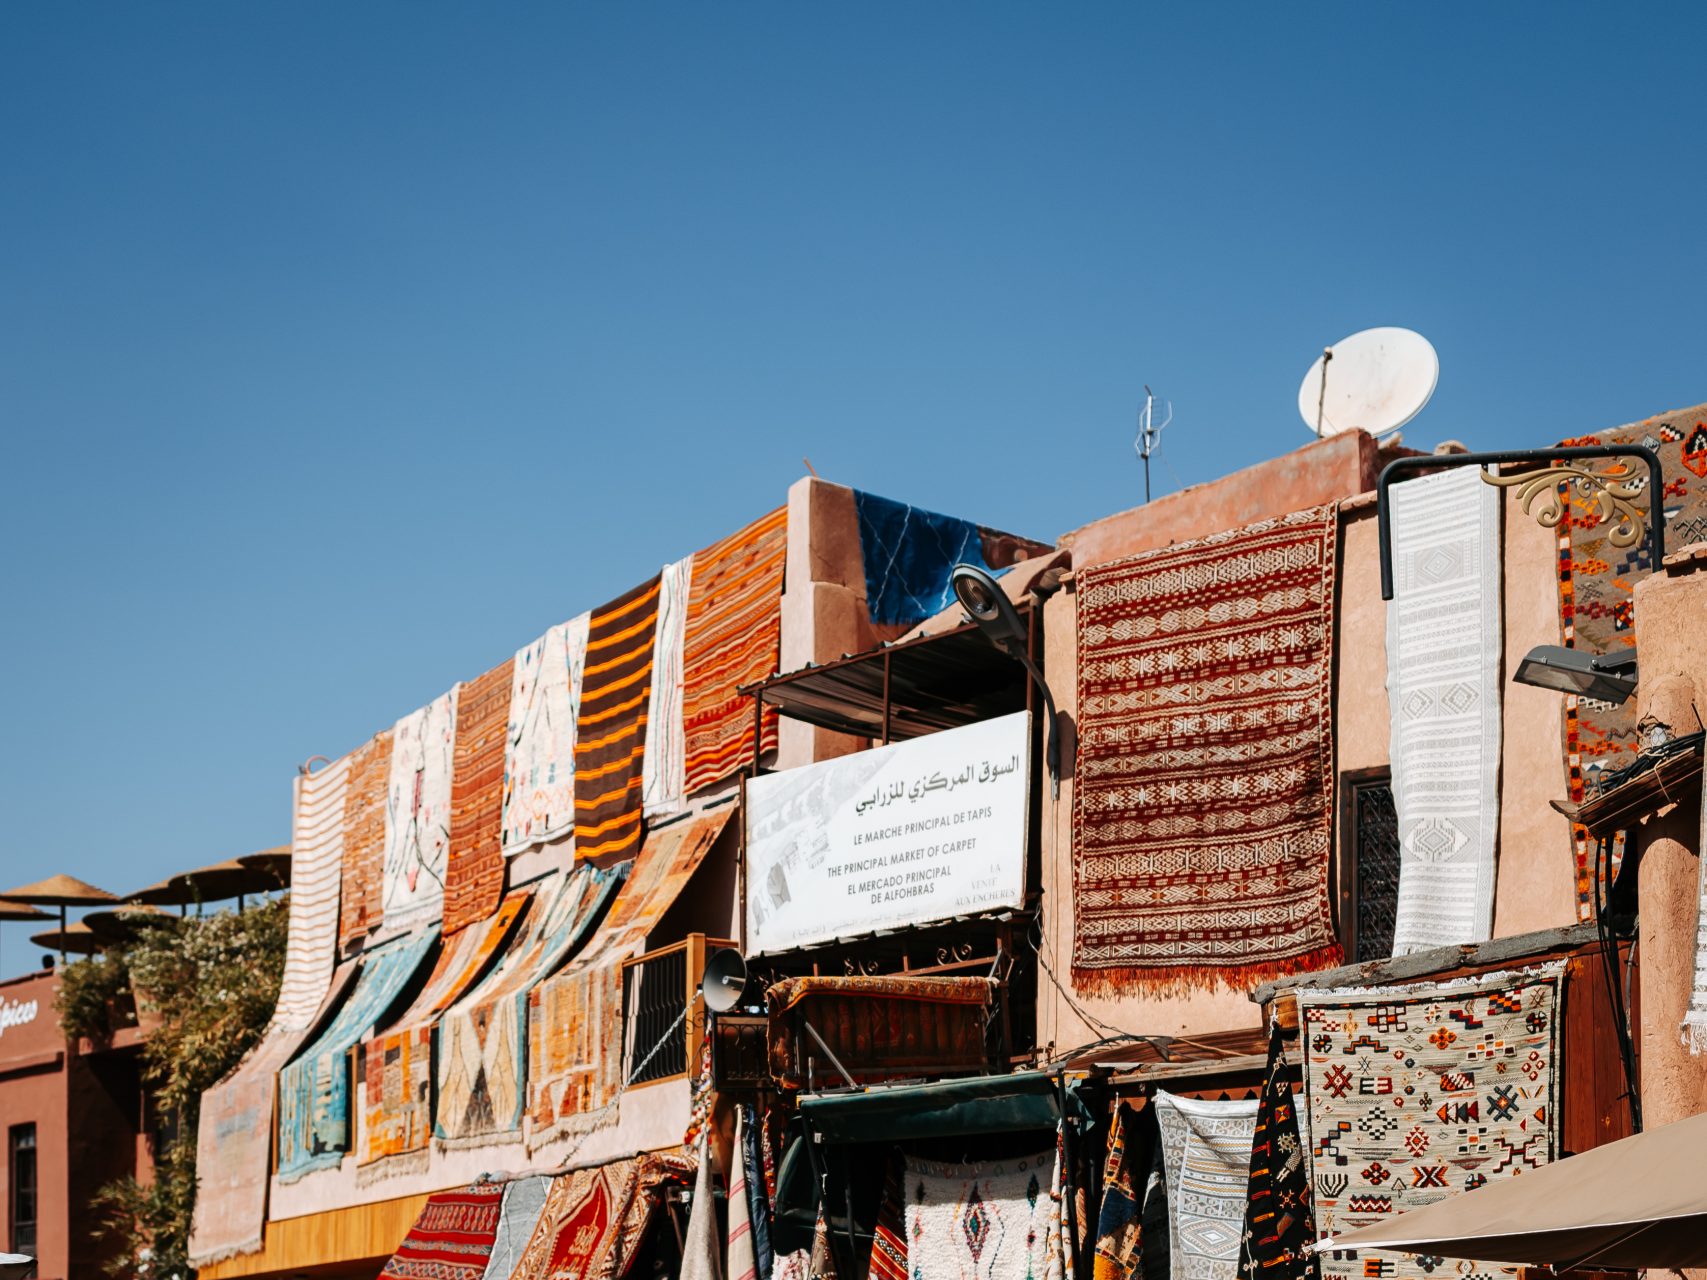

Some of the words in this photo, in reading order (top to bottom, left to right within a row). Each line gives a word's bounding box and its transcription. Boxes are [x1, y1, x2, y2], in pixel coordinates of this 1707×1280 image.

[908, 764, 975, 803] المركزي
[978, 754, 1020, 783] السوق
[855, 781, 905, 816] للزرابي
[853, 834, 863, 846] LE
[865, 825, 902, 844] MARCHE
[904, 815, 951, 835] PRINCIPAL
[953, 812, 965, 824] DE
[967, 806, 993, 822] TAPIS
[828, 865, 842, 878] THE
[844, 855, 888, 875] PRINCIPAL
[890, 847, 925, 865] MARKET
[927, 845, 940, 858] OF
[942, 838, 977, 855] CARPET
[847, 884, 857, 895] EL
[858, 874, 903, 893] MERCADO
[905, 865, 952, 884] PRINCIPAL
[871, 892, 882, 904] DE
[884, 882, 935, 903] ALFOHBRAS
